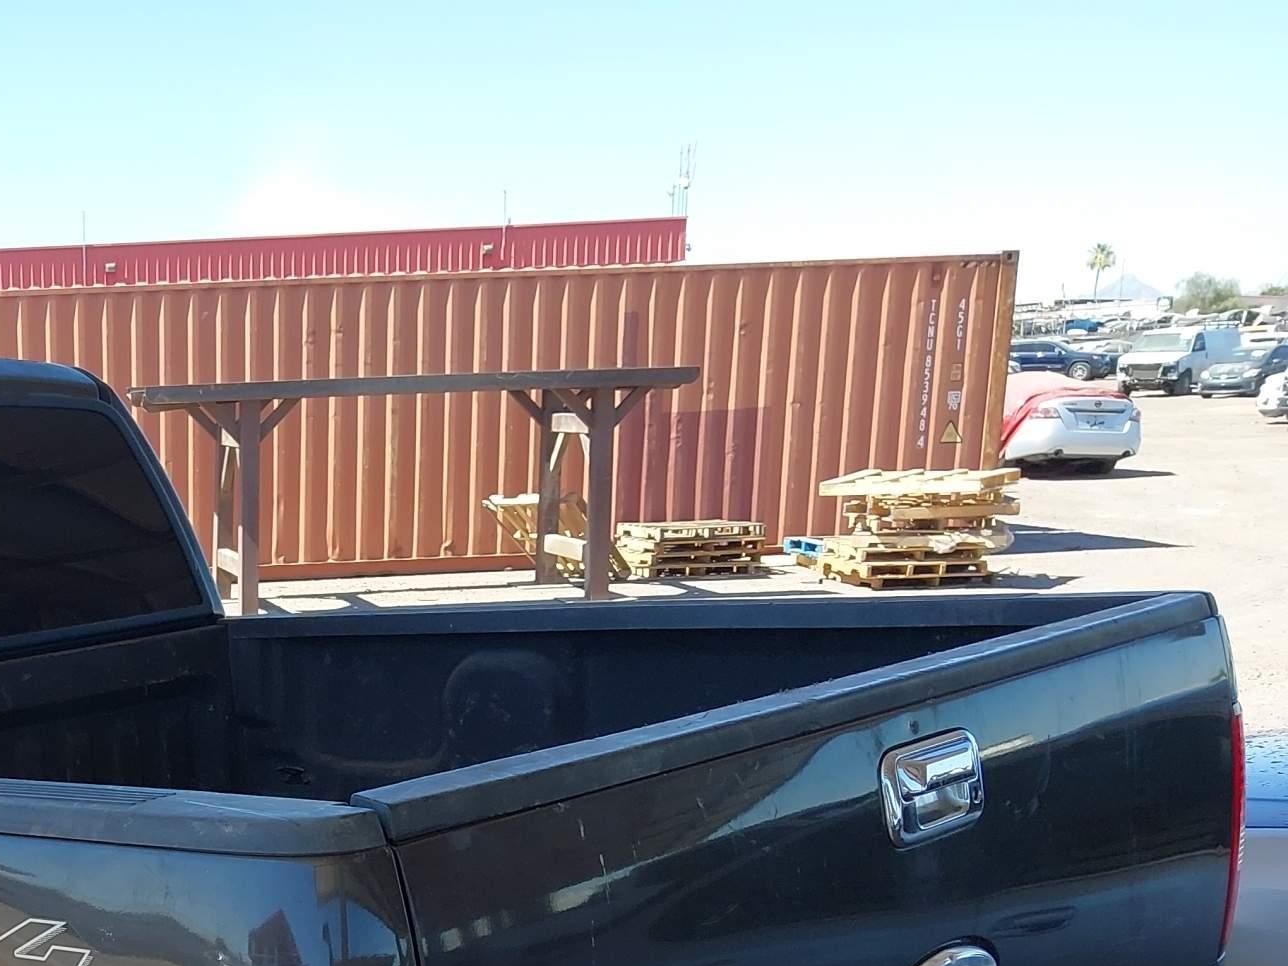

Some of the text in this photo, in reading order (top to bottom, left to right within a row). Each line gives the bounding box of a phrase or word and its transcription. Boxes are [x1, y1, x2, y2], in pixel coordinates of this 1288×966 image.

[917, 300, 936, 449] TCNU 853948 4
